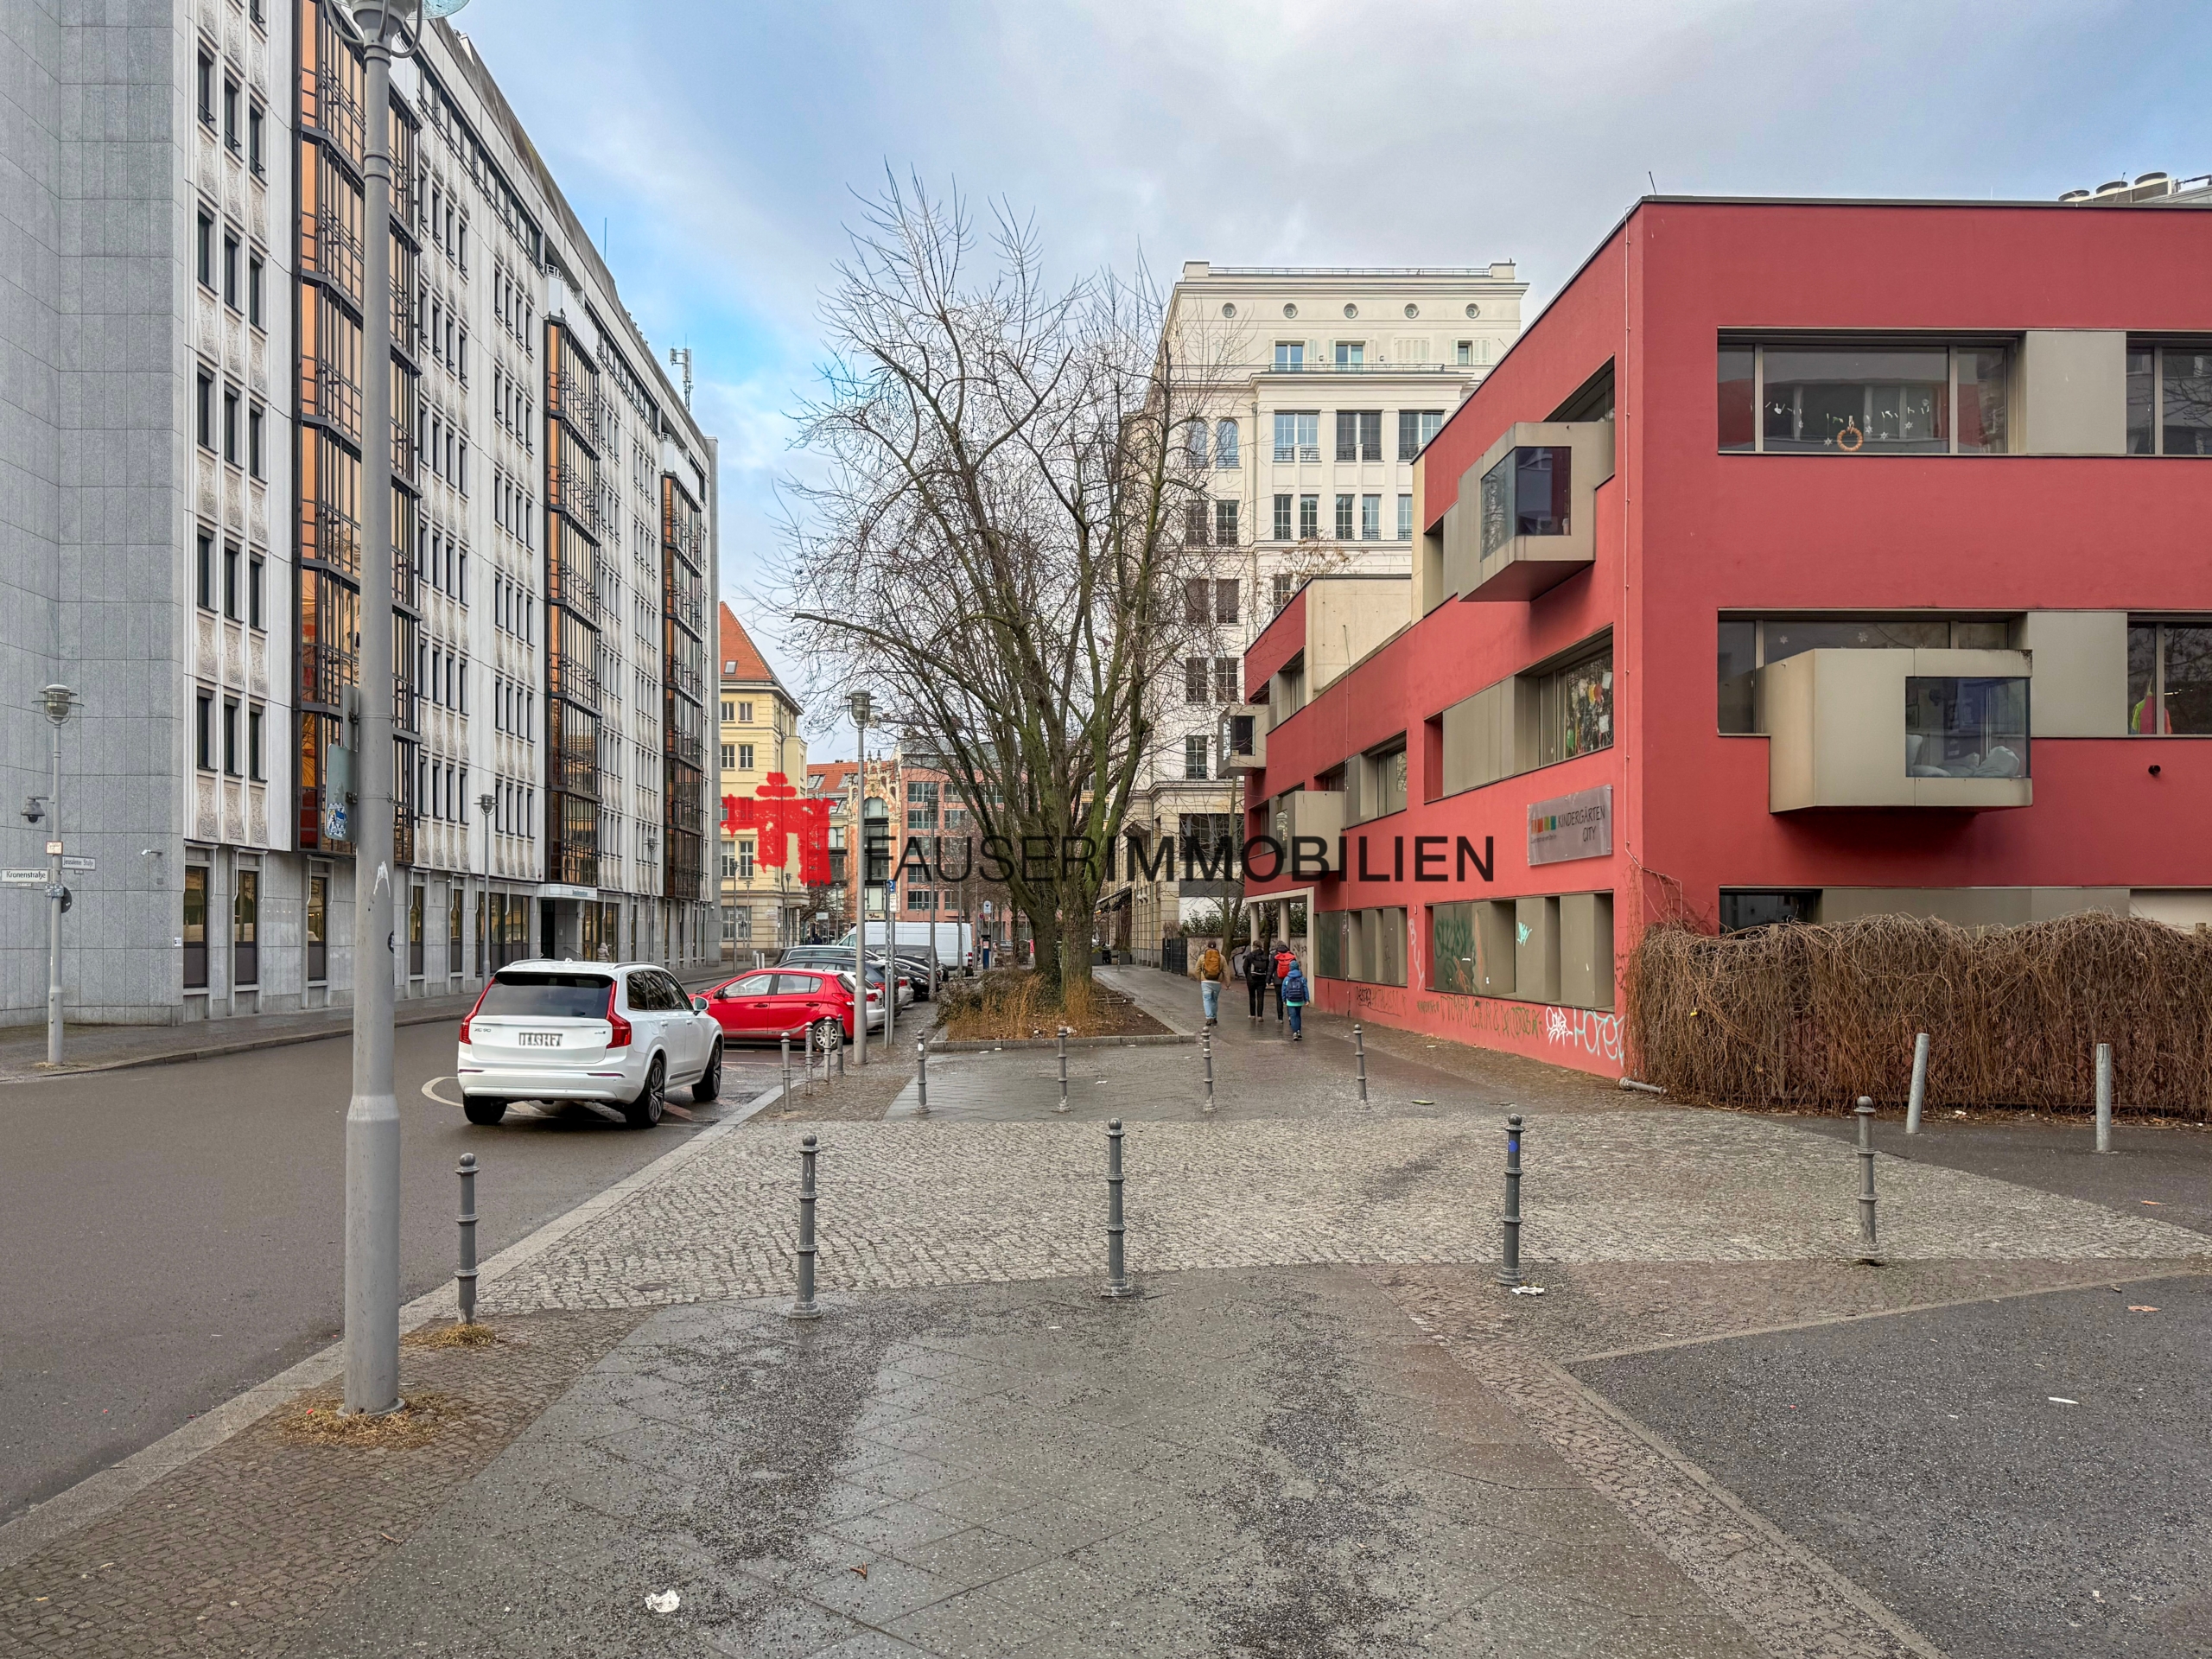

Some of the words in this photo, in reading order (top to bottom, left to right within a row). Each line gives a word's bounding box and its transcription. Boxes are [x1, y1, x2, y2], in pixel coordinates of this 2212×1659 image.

[1558, 805, 1605, 828] KINDERGÄRTEN
[1582, 825, 1597, 842] CITY
[6, 871, 46, 880] Kronenstraße
